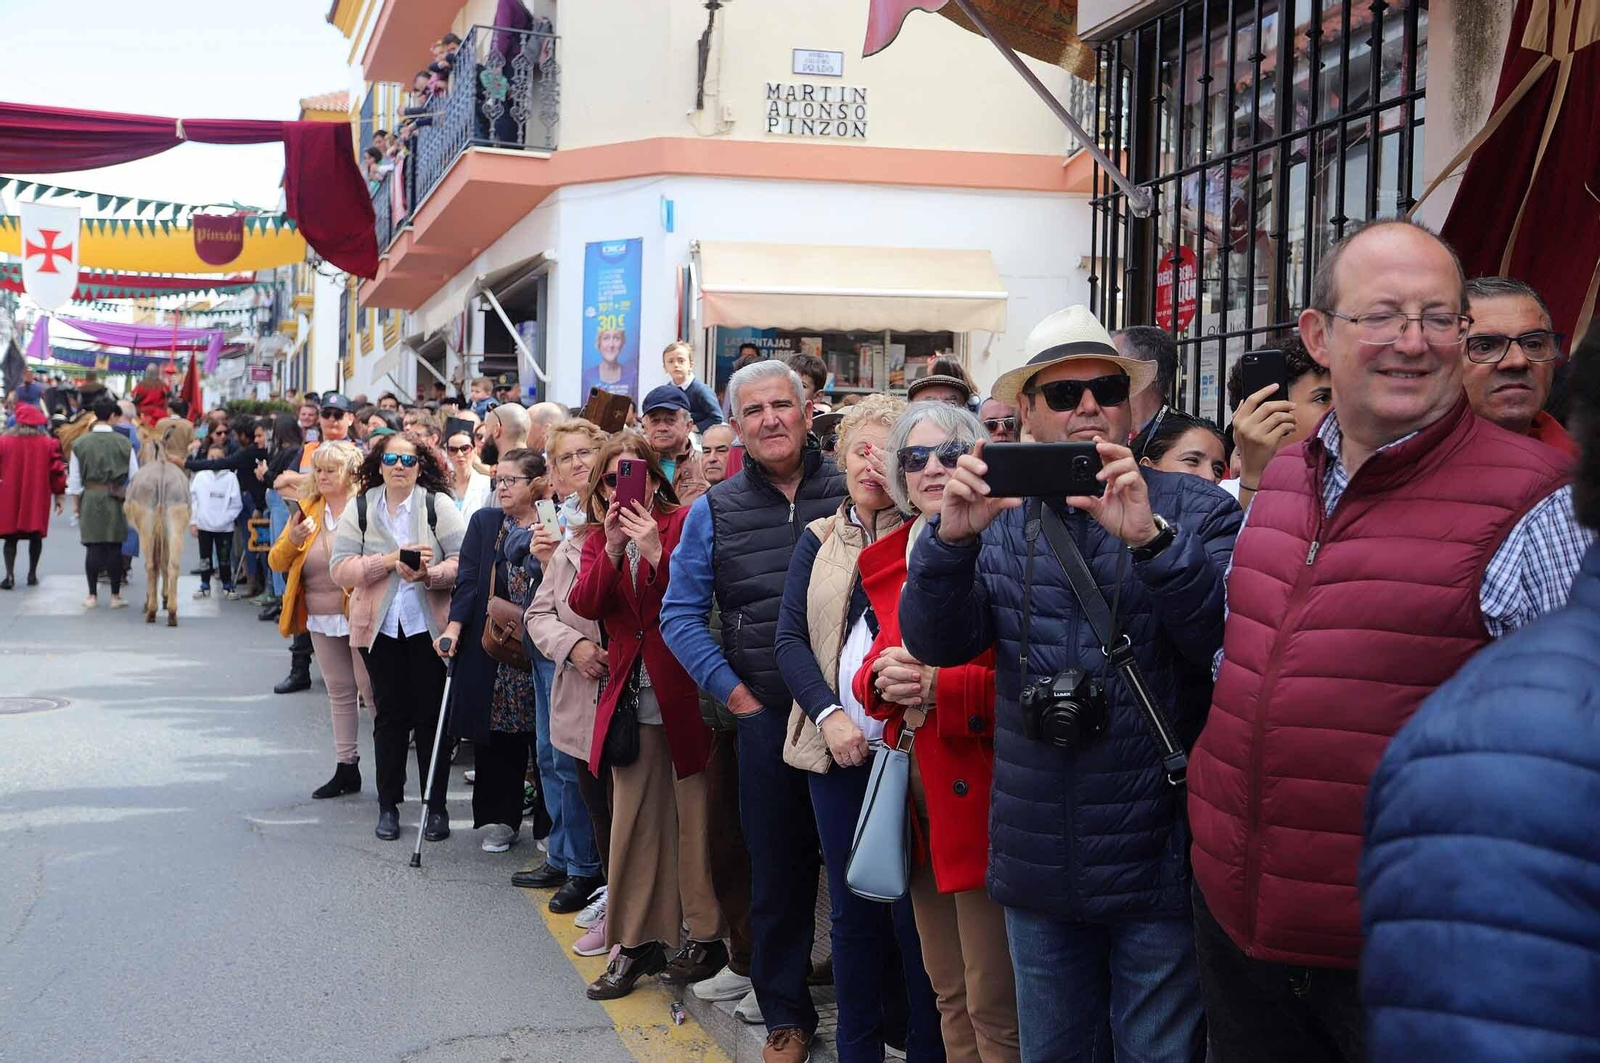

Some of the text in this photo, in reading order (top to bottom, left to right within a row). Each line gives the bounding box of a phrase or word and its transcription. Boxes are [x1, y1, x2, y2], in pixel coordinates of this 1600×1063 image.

[766, 83, 868, 104] MARTIN
[768, 101, 866, 120] ALONSO
[768, 118, 867, 138] PINZON
[597, 314, 625, 332] 30€
[743, 337, 791, 348] VENTAJAS
